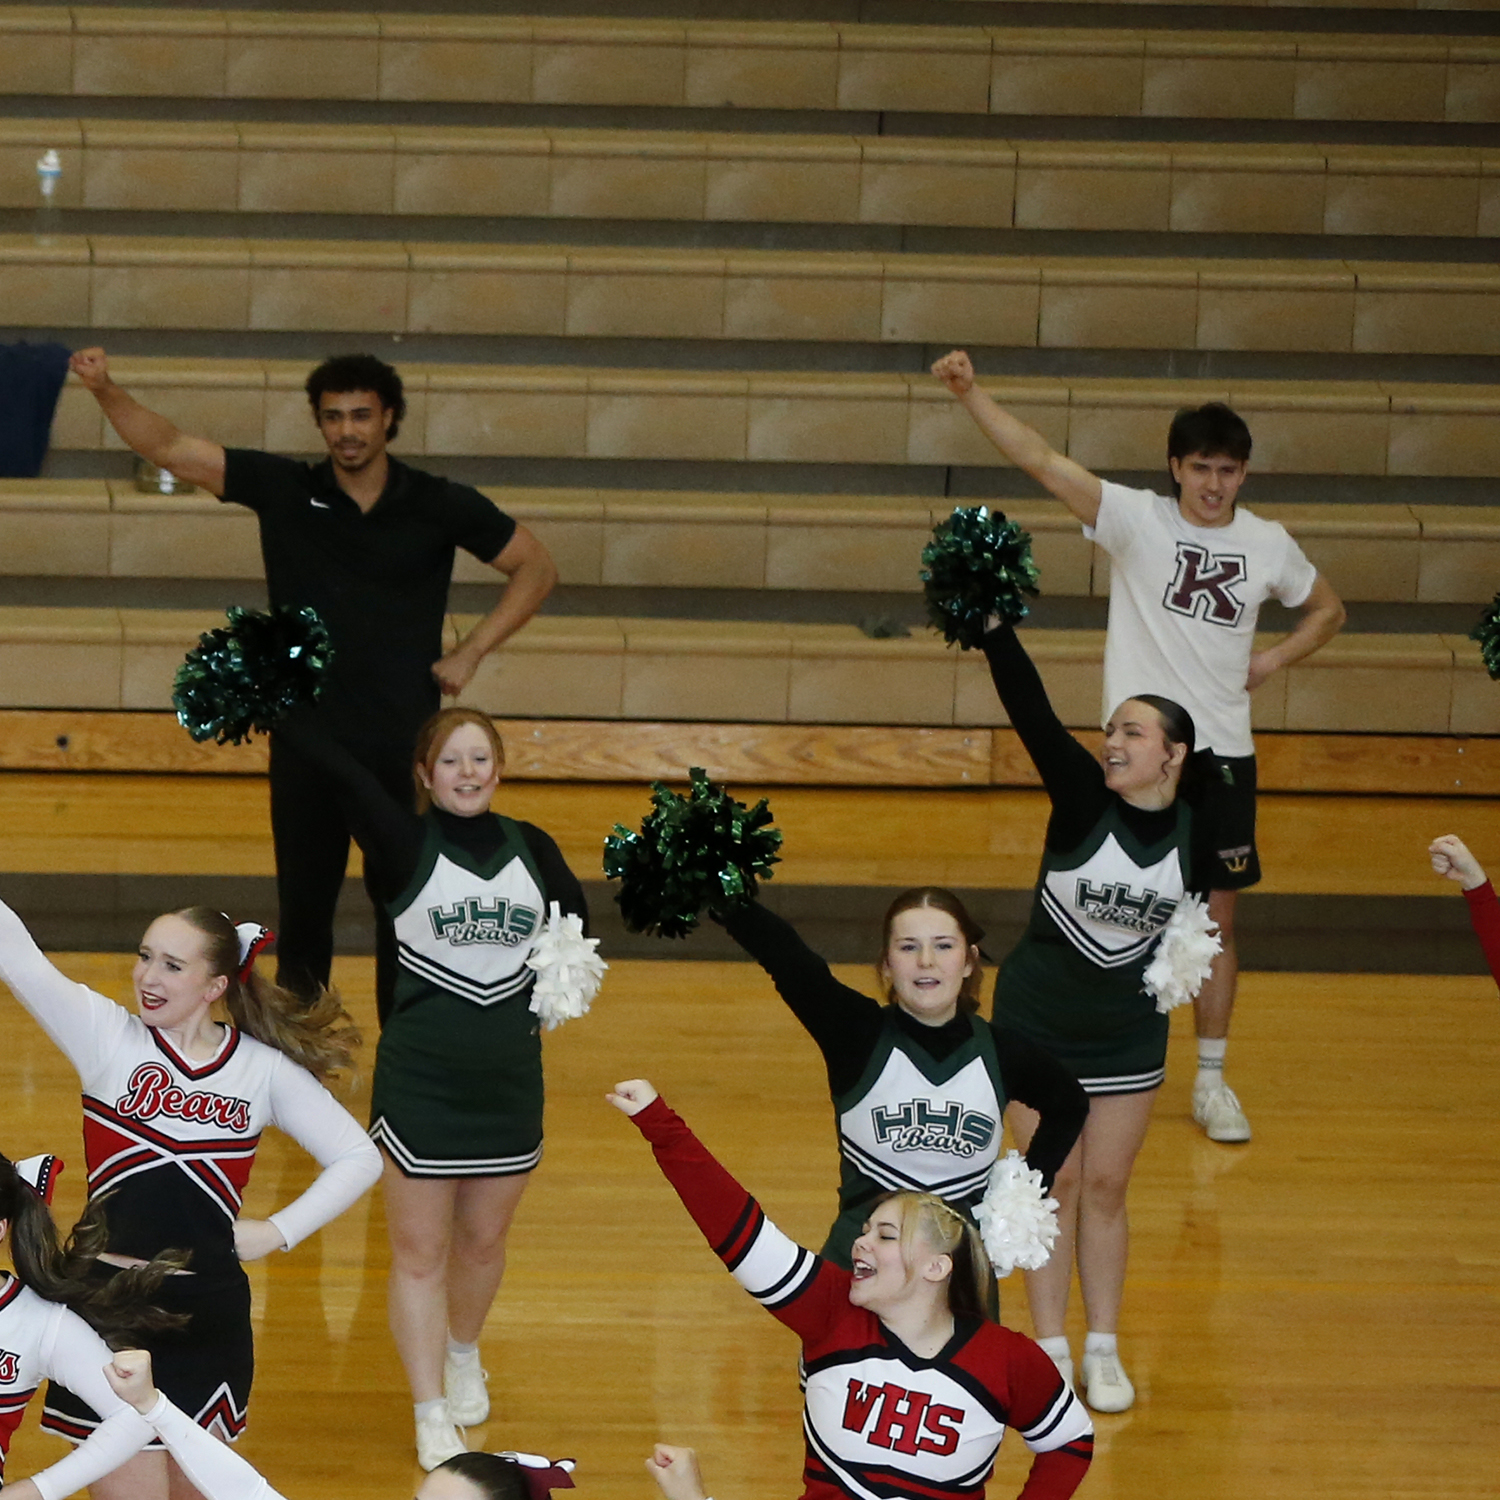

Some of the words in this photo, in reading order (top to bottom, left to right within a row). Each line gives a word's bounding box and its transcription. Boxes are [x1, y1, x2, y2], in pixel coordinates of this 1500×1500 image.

[1162, 541, 1248, 628] K
[427, 896, 539, 941] HHS
[1075, 878, 1178, 926] HHS
[449, 921, 521, 947] Bears
[117, 1061, 252, 1134] Bears
[871, 1098, 997, 1153] HHS
[892, 1126, 976, 1159] Bears
[841, 1377, 966, 1457] WHS
